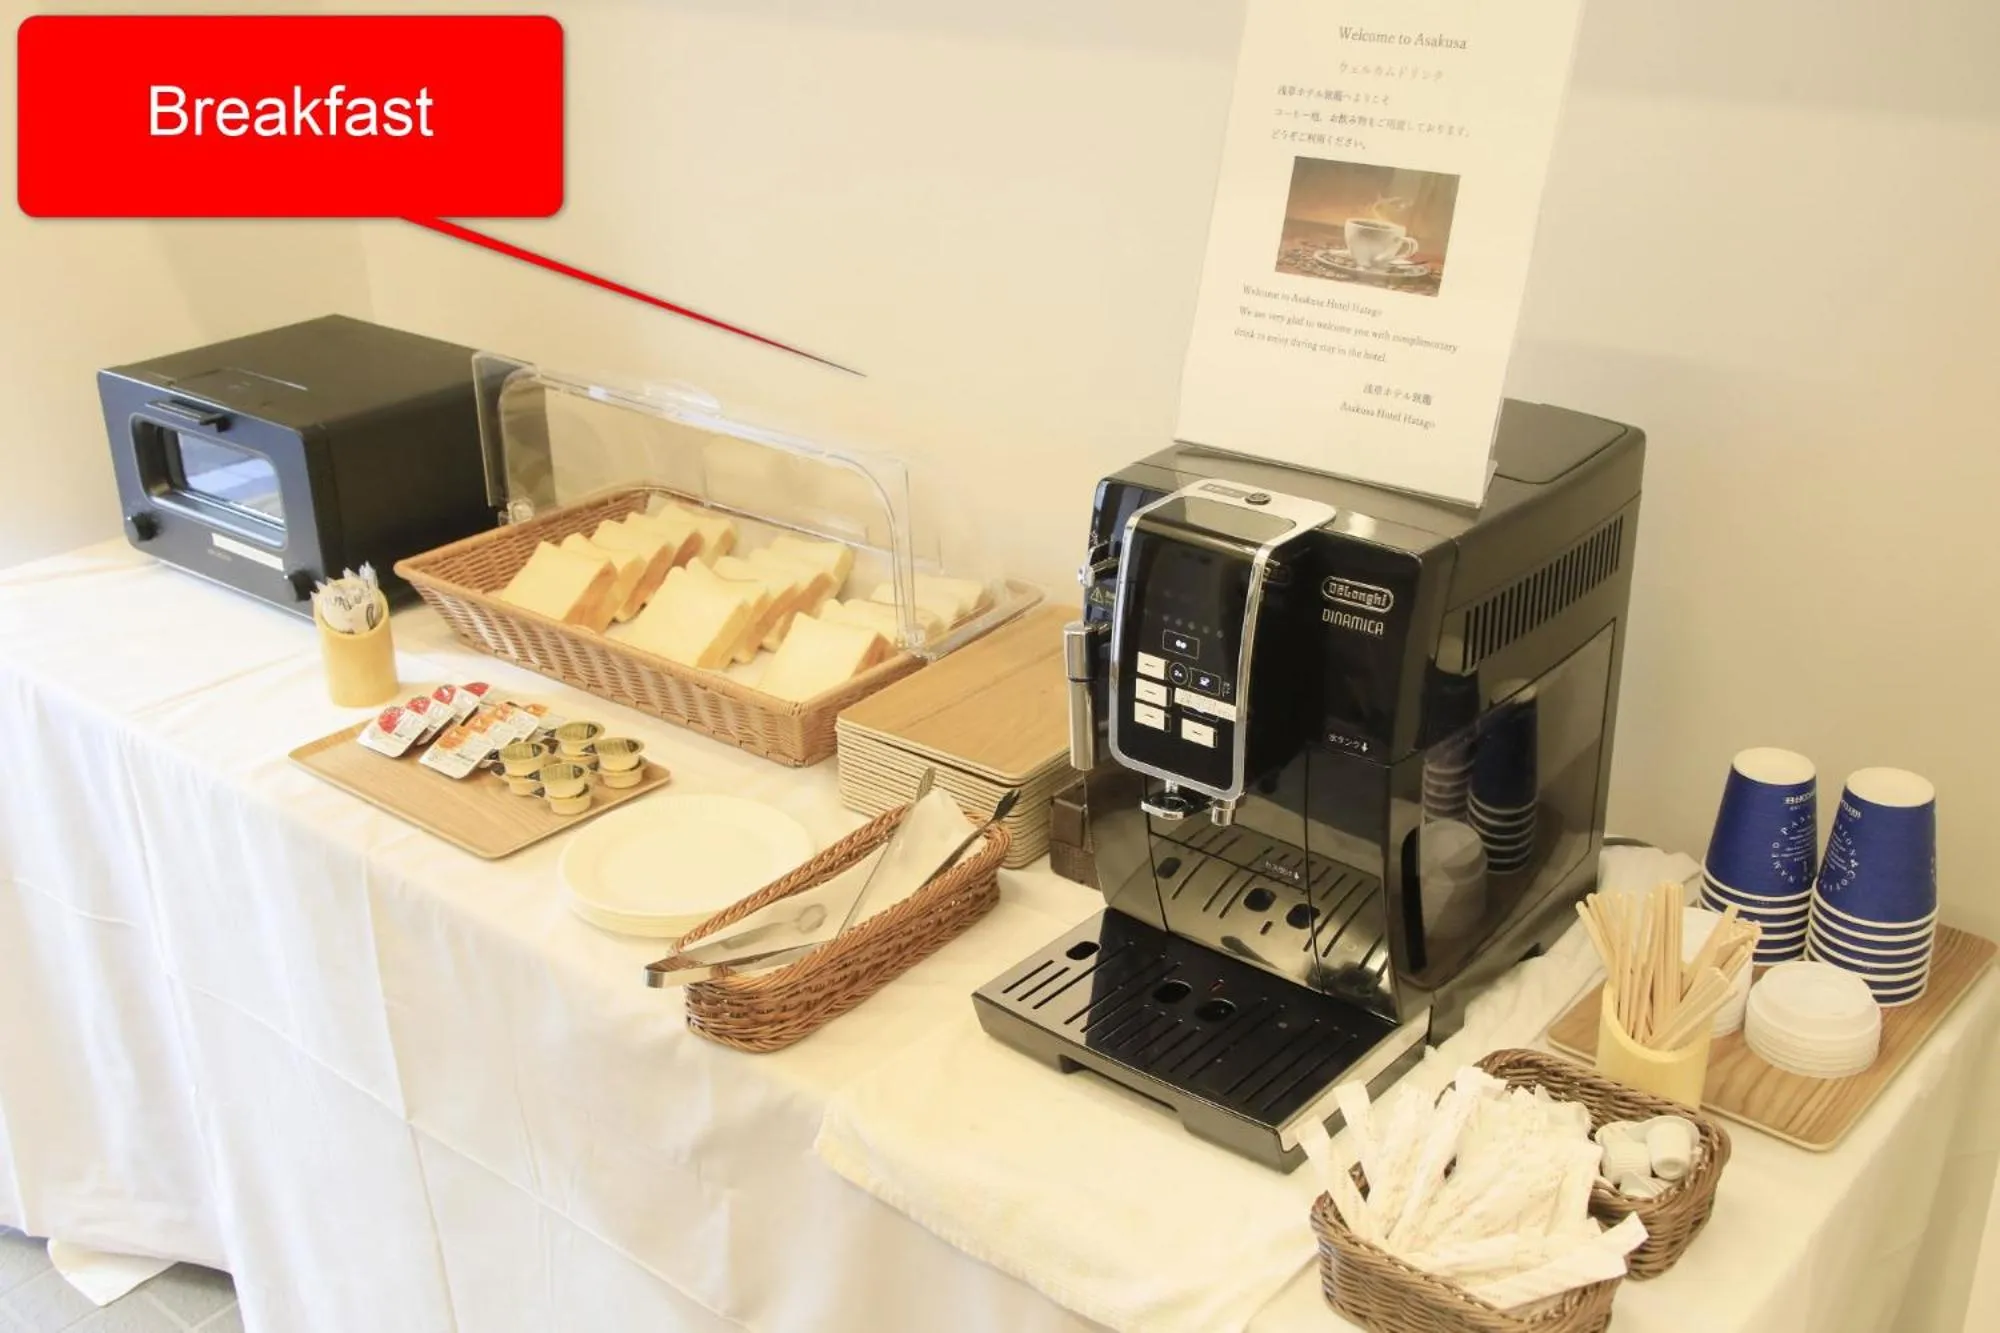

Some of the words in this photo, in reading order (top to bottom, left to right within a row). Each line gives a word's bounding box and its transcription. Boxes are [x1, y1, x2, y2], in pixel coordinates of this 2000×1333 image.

[1339, 25, 1396, 45] Welcome
[1398, 33, 1412, 45] to
[1413, 32, 1467, 50] Asakusa
[1339, 60, 1444, 83] ウェルカムドリンク
[1243, 284, 1280, 300] Welcome
[1291, 293, 1324, 307] Asakusa
[1326, 298, 1350, 311] Hotel
[1352, 302, 1383, 317] Hatago
[1238, 306, 1252, 316] We
[1253, 310, 1266, 319] are
[1268, 313, 1285, 324] very
[1286, 315, 1304, 327] glad
[1305, 319, 1315, 327] to
[1316, 320, 1352, 335] welcome
[1353, 327, 1370, 338] you
[1371, 328, 1391, 341] with
[1234, 326, 1255, 339] drink
[1266, 334, 1289, 347] enjoy
[1290, 338, 1318, 352] during
[1319, 344, 1337, 355] stay
[1338, 347, 1347, 356] in
[1348, 347, 1362, 359] the
[1339, 401, 1376, 417] Asakusa
[1376, 408, 1401, 423] Hotel
[1402, 413, 1436, 431] Hatago
[1321, 607, 1384, 636] DINAMICA
